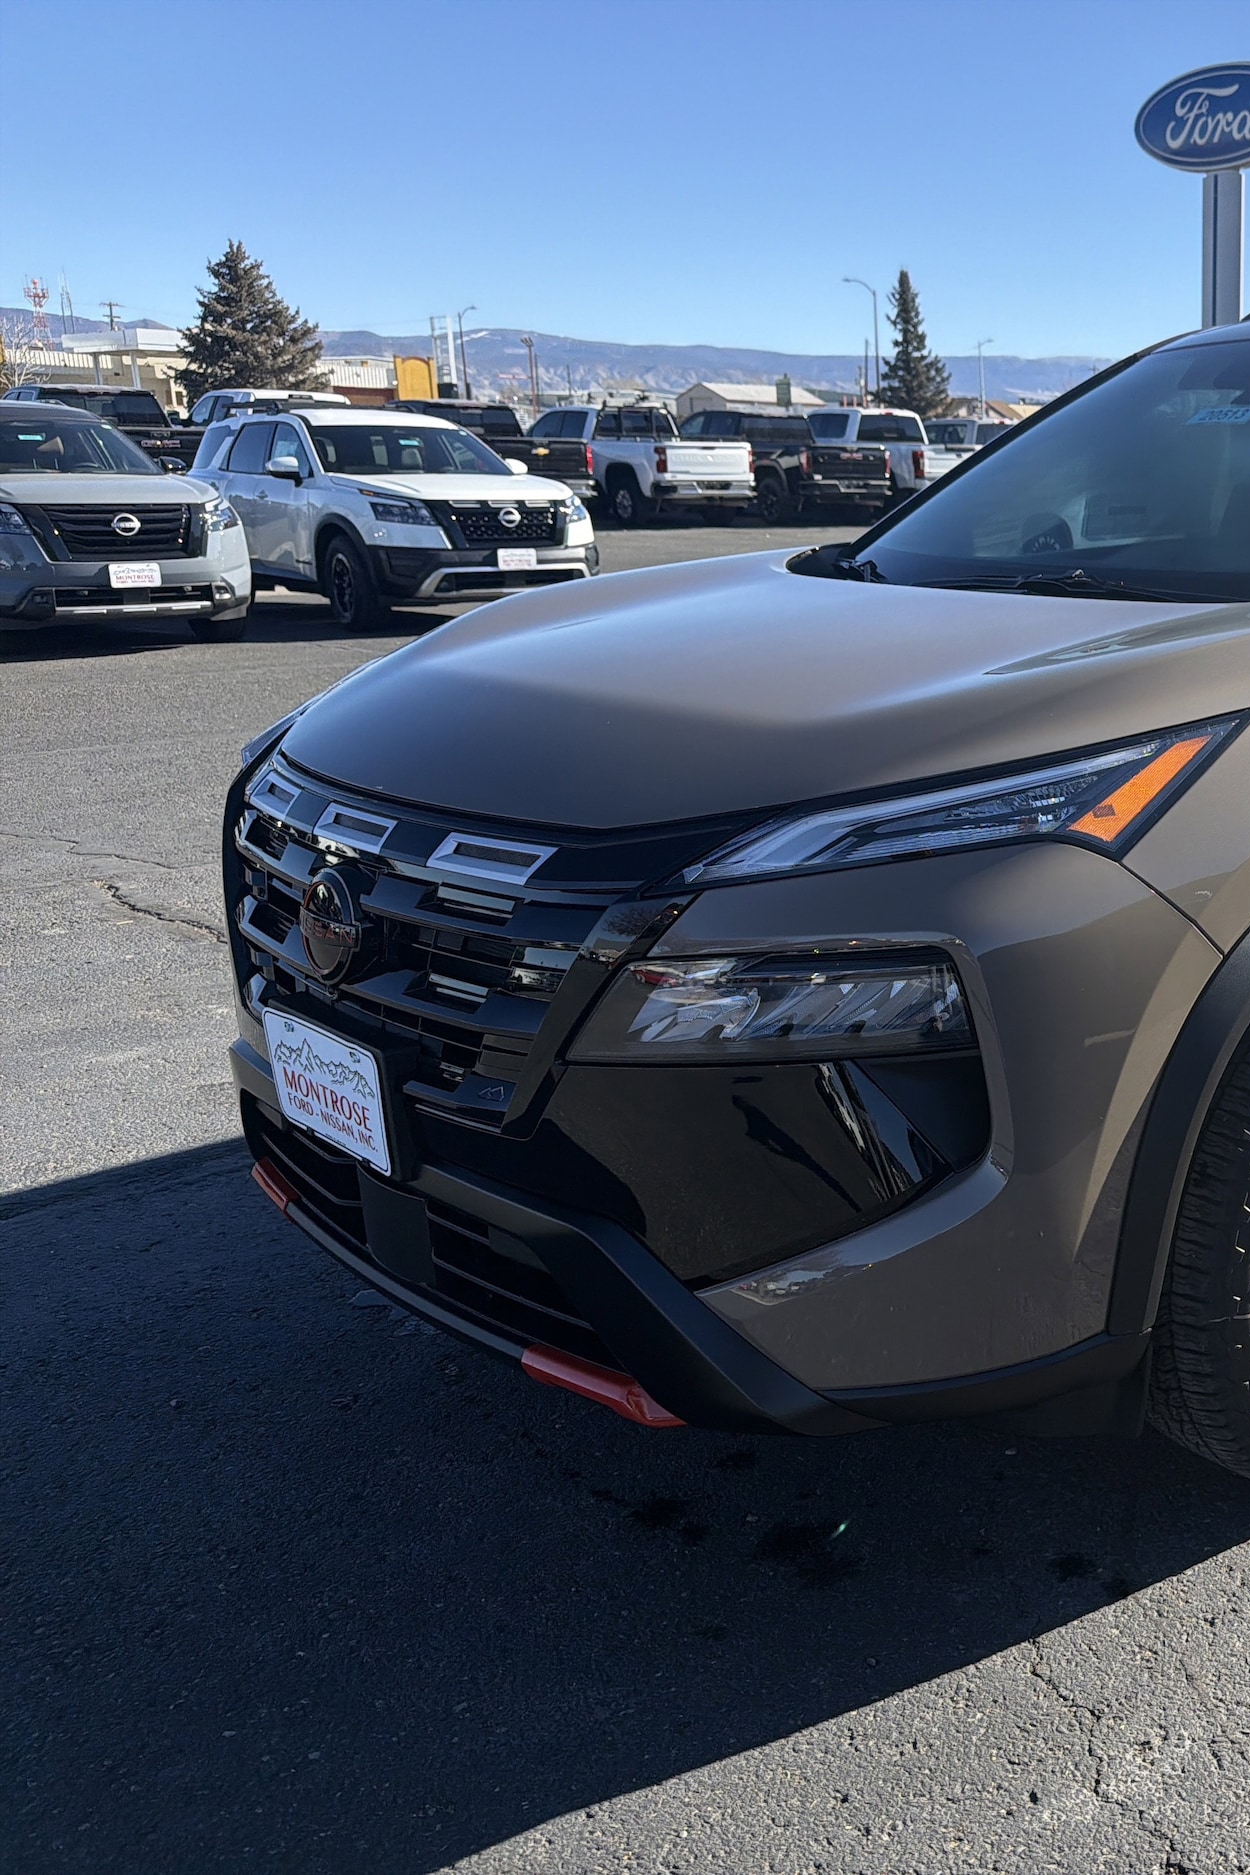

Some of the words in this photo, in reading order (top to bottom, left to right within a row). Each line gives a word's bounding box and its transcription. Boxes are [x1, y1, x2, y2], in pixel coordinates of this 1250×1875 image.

[282, 1066, 373, 1133] MONTROSE
[287, 1092, 314, 1116] FORD
[320, 1108, 358, 1144] NISSAN,
[358, 1129, 379, 1153] INC.
